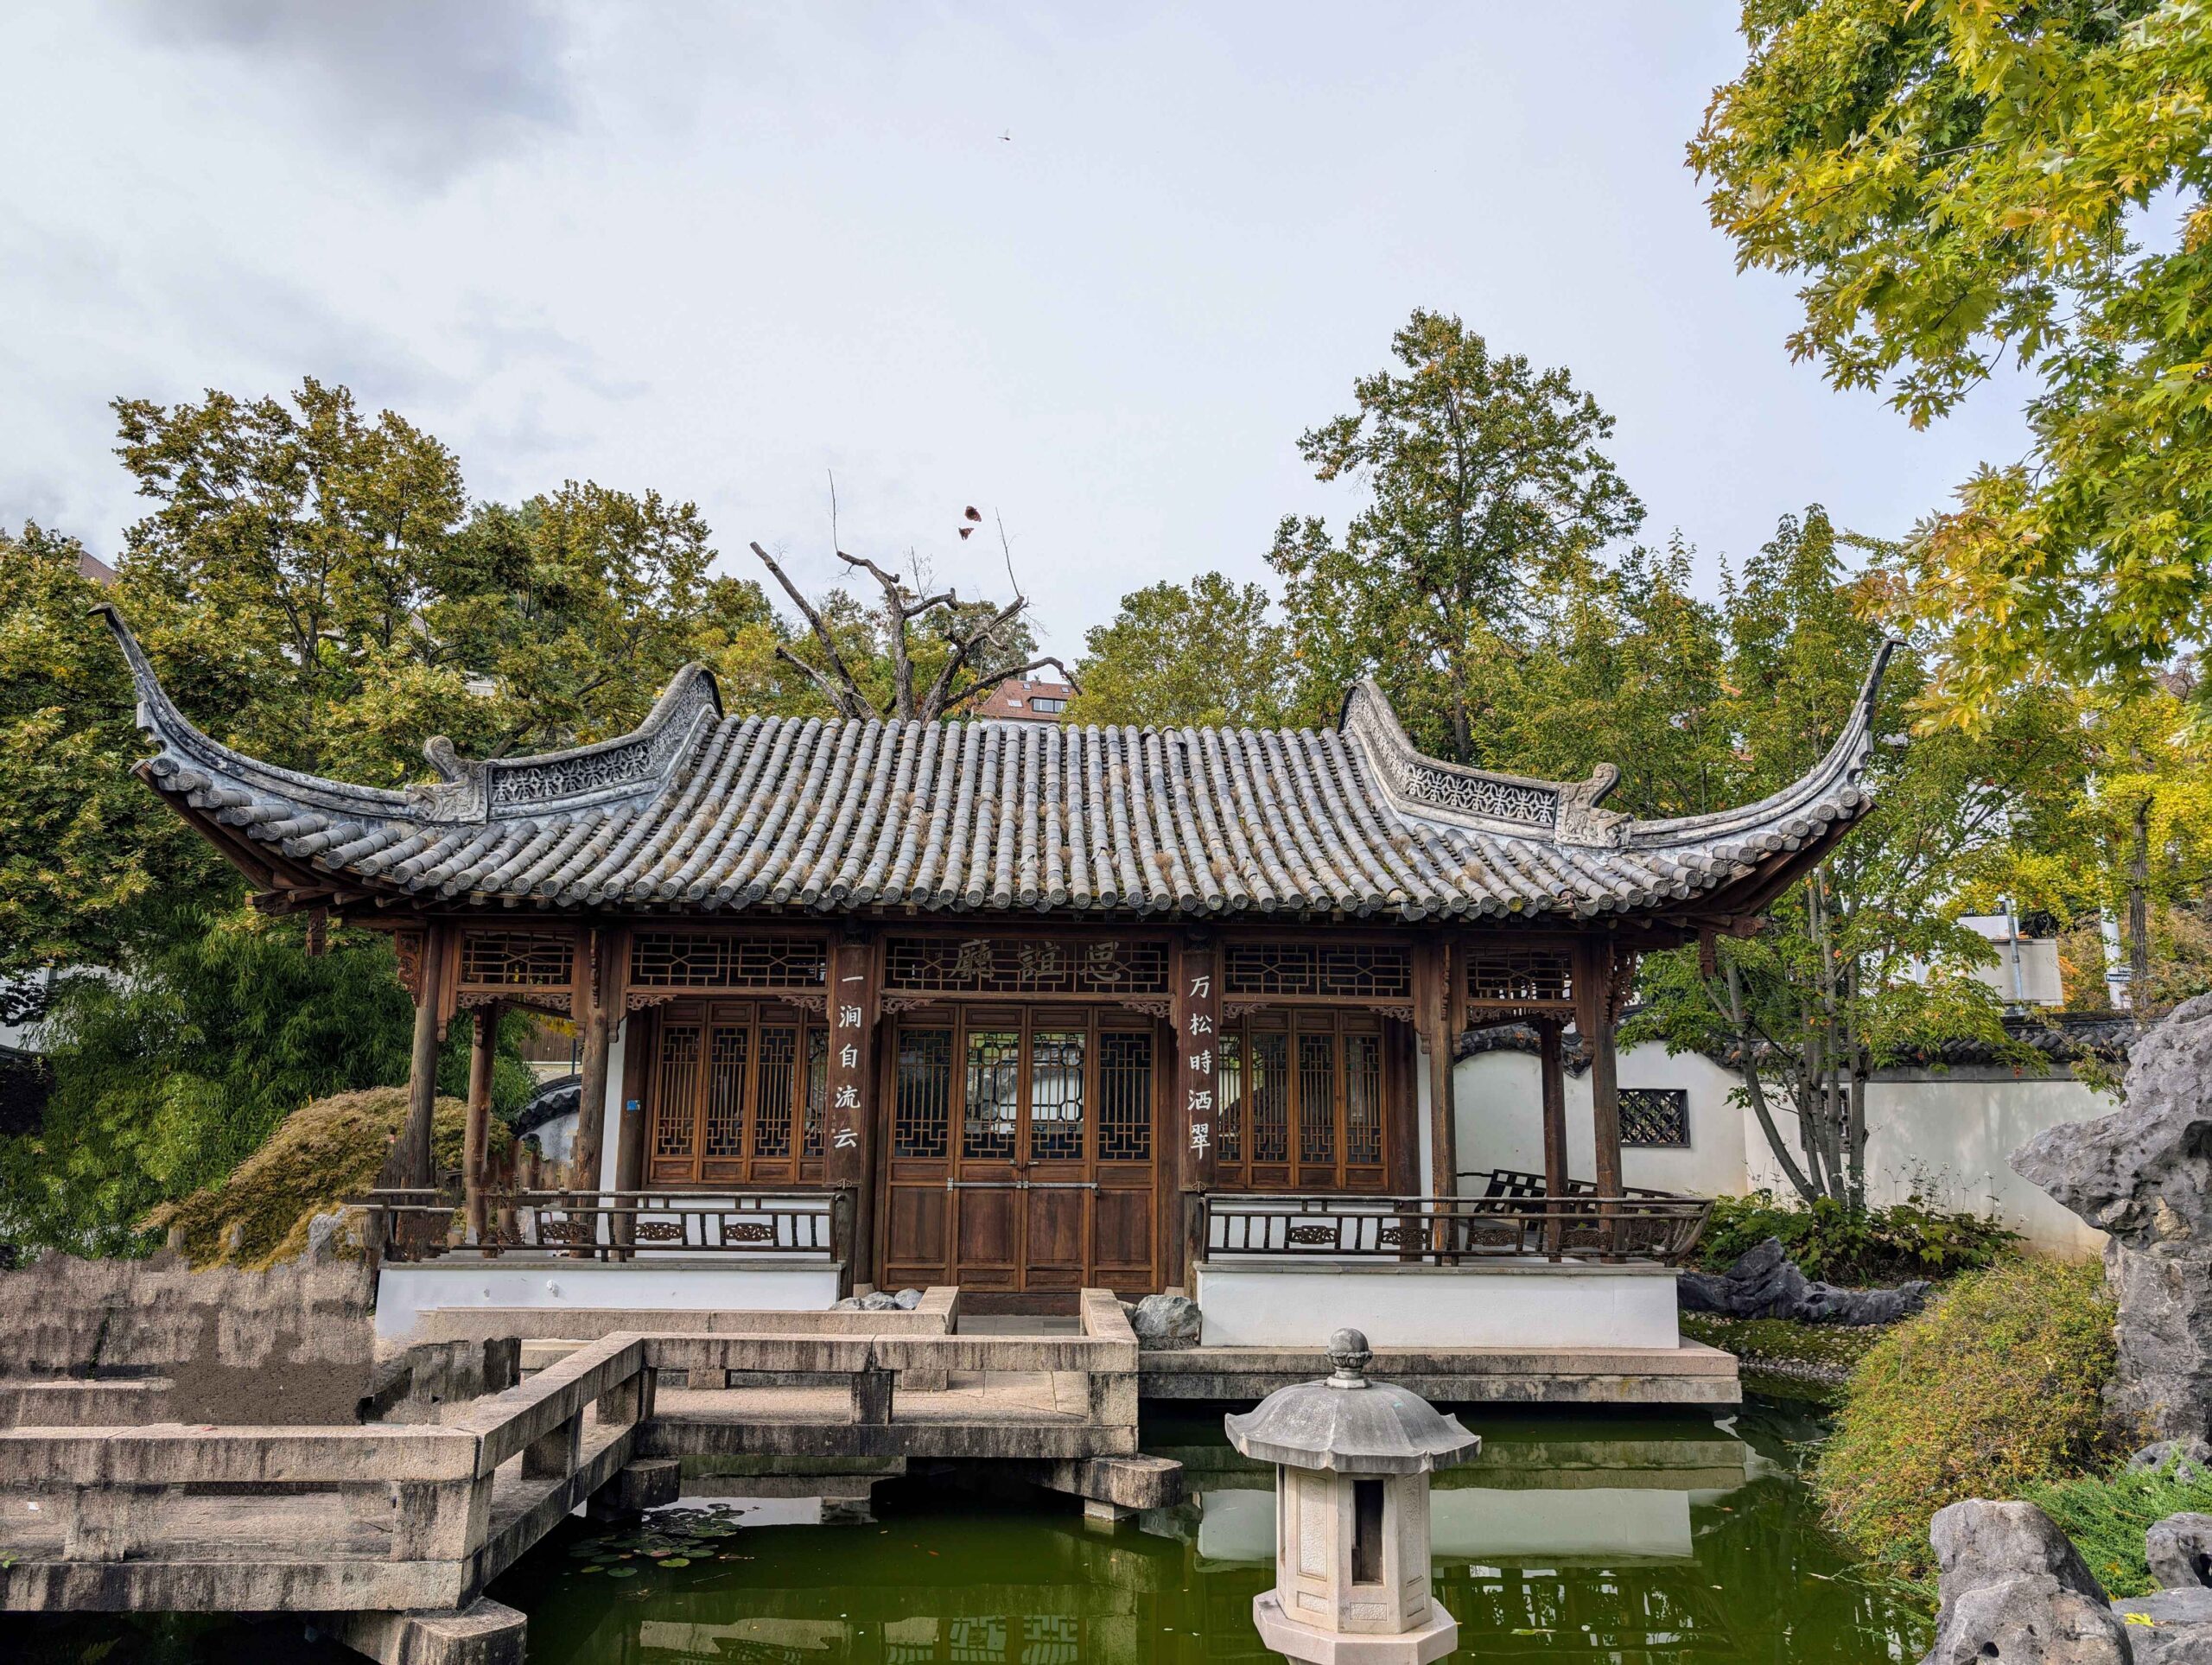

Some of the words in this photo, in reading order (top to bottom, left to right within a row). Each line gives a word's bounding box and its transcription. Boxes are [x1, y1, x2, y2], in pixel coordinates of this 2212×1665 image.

[1187, 975, 1213, 1160] 万松時洒翠
